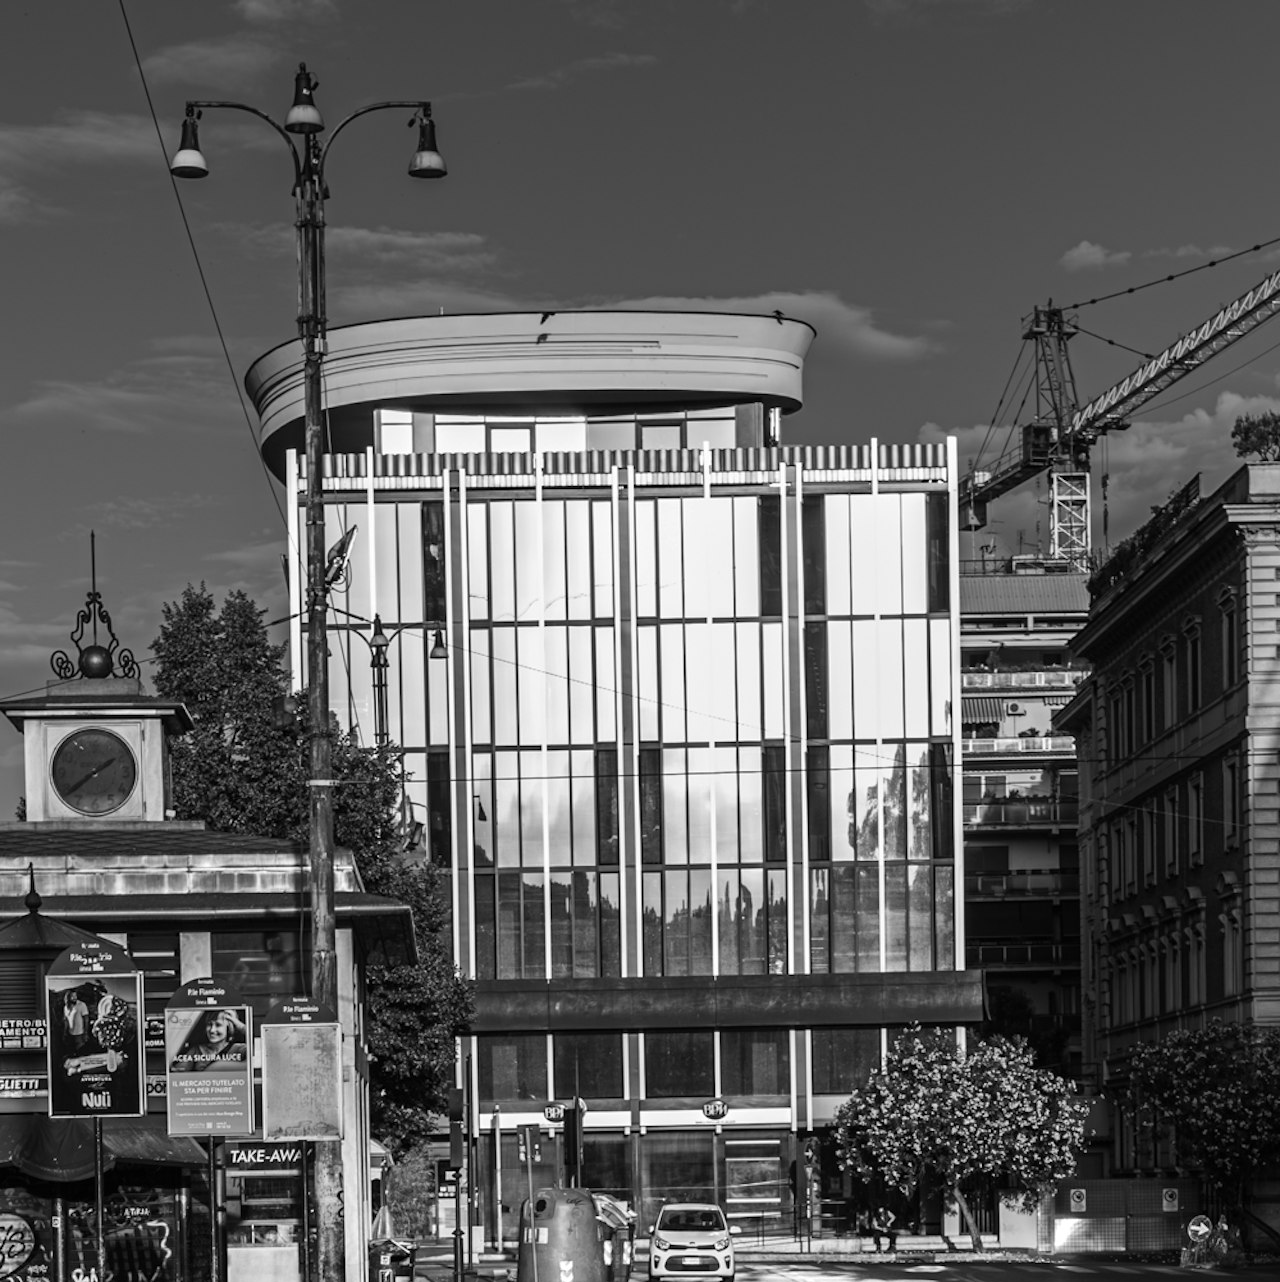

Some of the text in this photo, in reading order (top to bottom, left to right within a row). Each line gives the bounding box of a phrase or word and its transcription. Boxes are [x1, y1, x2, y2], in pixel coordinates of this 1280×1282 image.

[199, 987, 226, 996] Flaminio
[294, 1004, 320, 1013] Flaminio
[173, 1053, 242, 1063] ACEA SICURA LUCE
[172, 1079, 245, 1088] IL MERCATO TUTELATO
[184, 1086, 233, 1095] STA PER FINIRE
